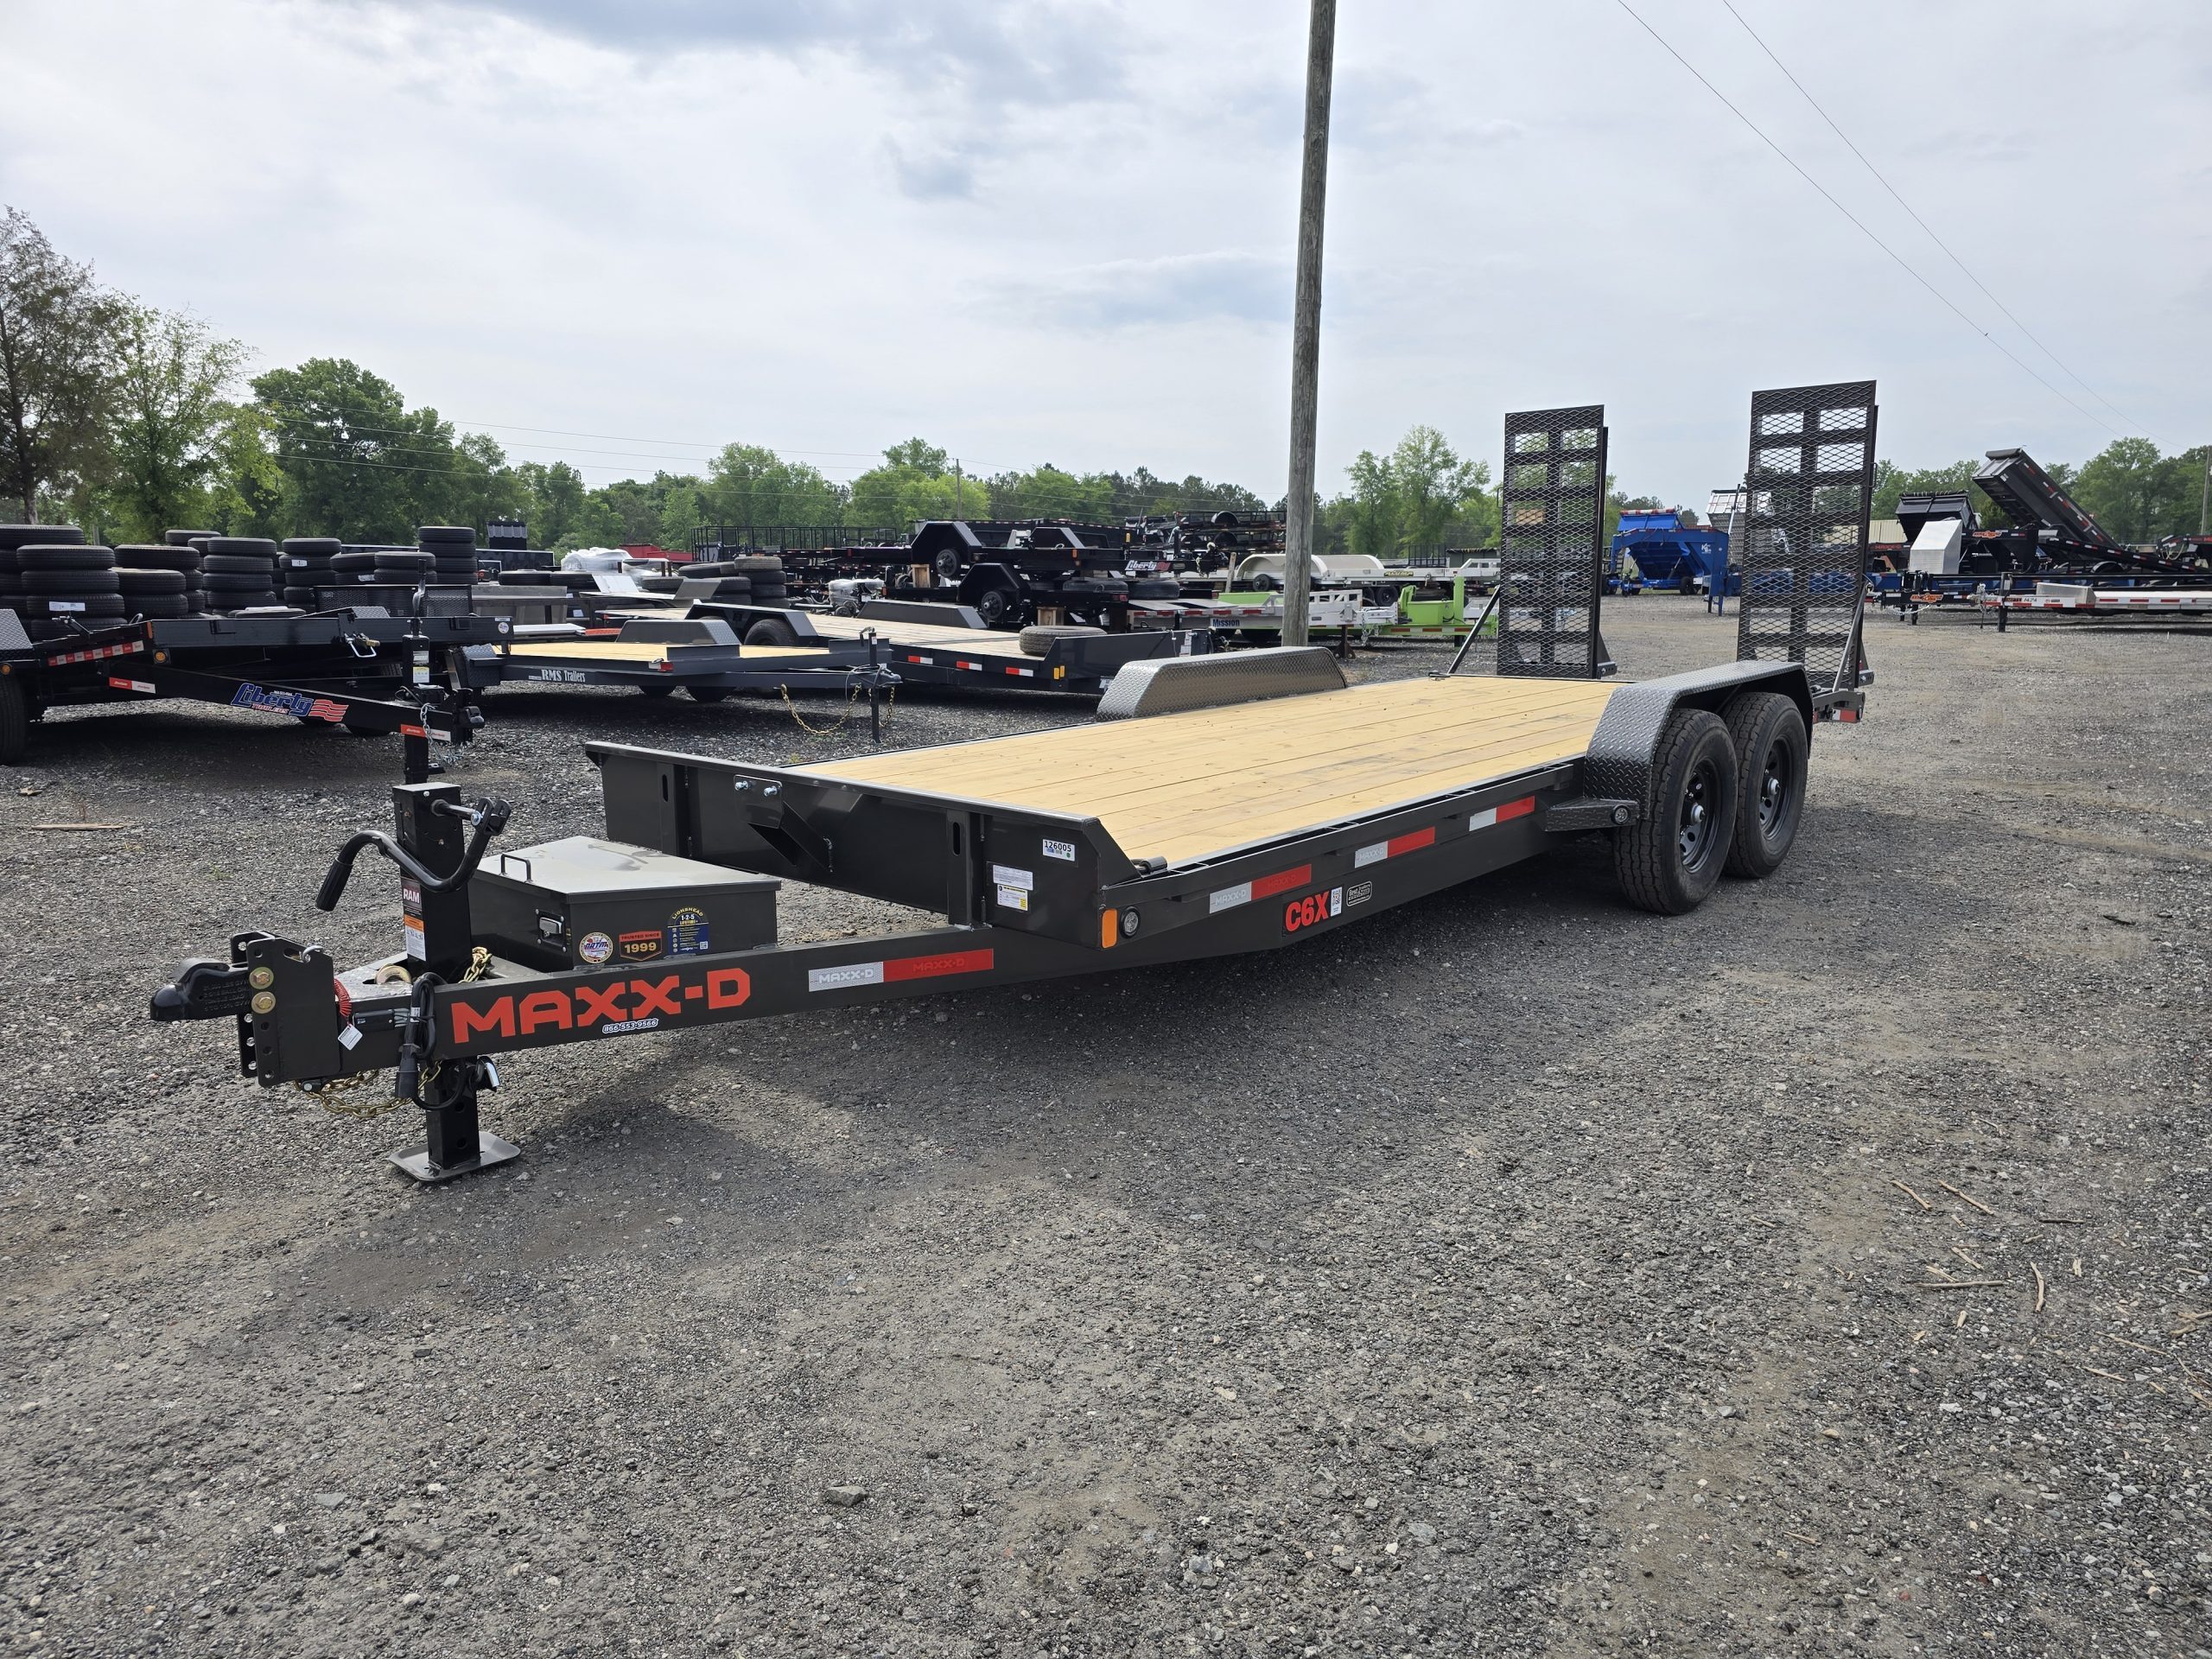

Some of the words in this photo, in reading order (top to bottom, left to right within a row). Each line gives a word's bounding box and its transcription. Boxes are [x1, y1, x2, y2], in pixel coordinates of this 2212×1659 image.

[1125, 560, 1157, 570] Liberty
[1212, 618, 1240, 627] Mission
[541, 669, 562, 681] RMS
[564, 671, 586, 682] Trailers
[231, 683, 314, 716] Liberty
[1044, 841, 1071, 852] 126005
[403, 888, 420, 904] RAM
[1215, 889, 1246, 906] MAXX-D
[671, 907, 703, 919] LIONSHEAD
[1286, 891, 1329, 931] C6X
[624, 942, 657, 953] 1999
[912, 958, 965, 972] MAXX-D
[818, 969, 874, 983] MAXX-D
[451, 968, 751, 1044] MAXX-D
[603, 1020, 658, 1033] 866-553-9566
